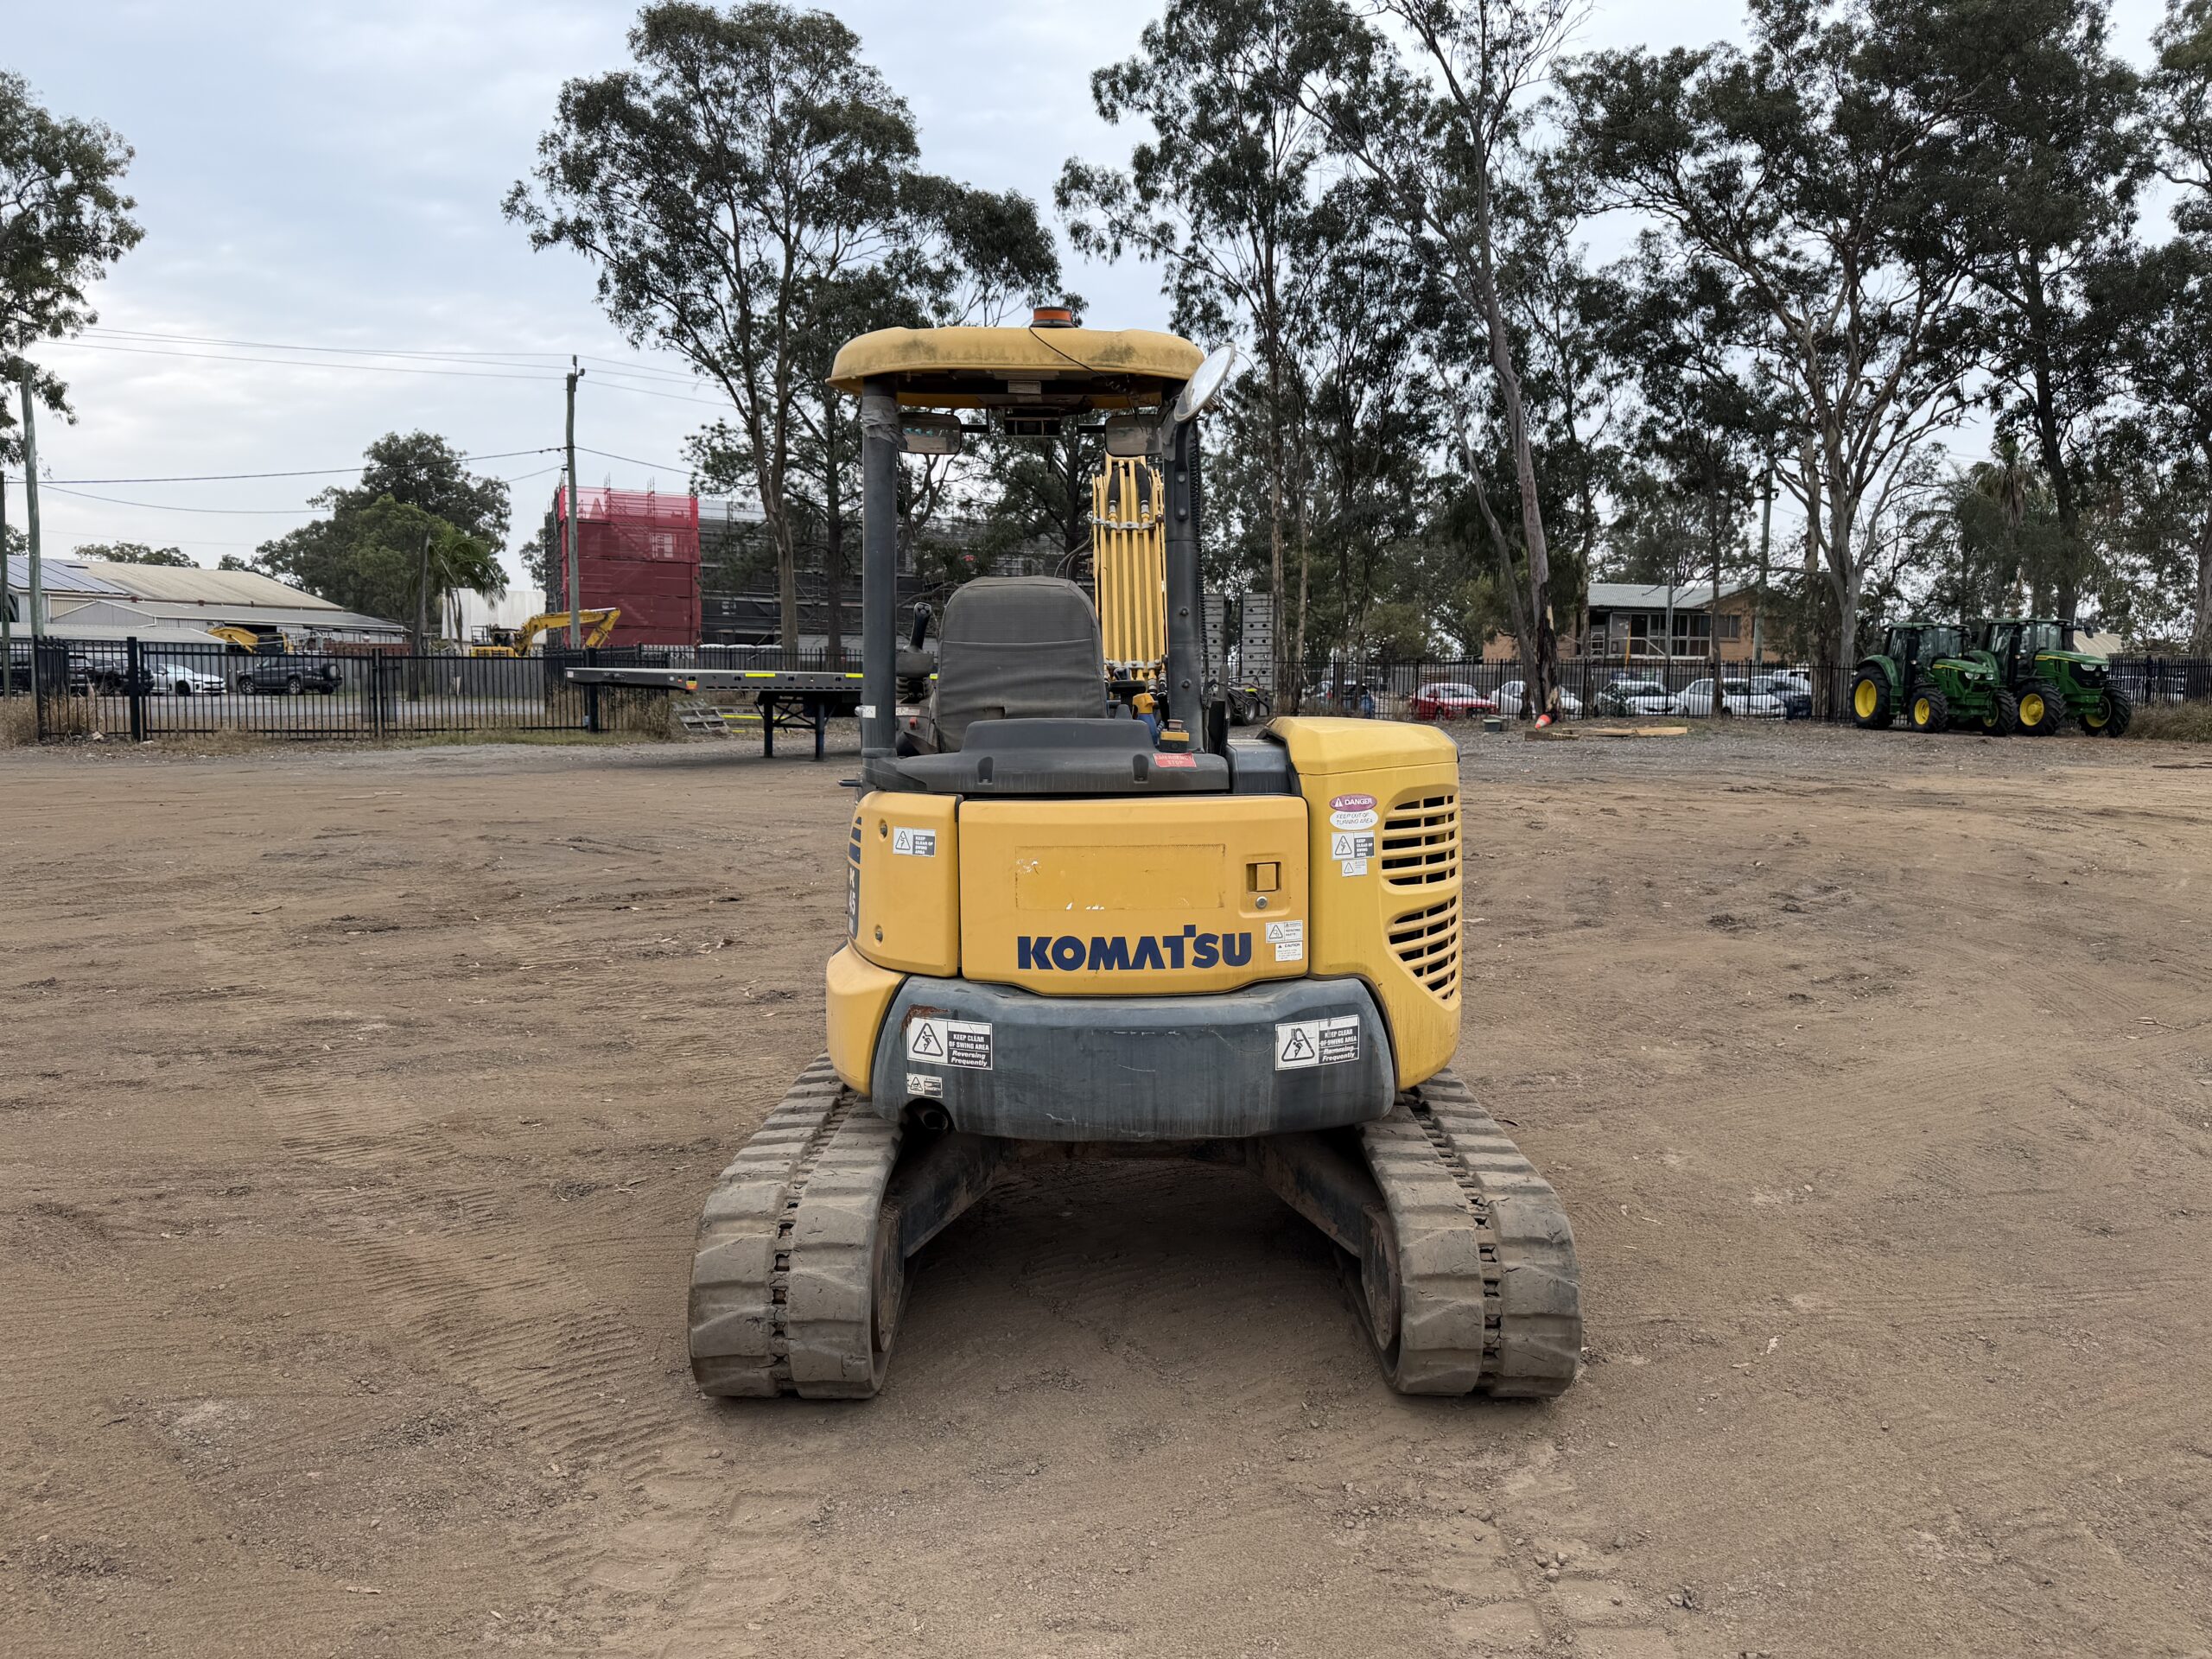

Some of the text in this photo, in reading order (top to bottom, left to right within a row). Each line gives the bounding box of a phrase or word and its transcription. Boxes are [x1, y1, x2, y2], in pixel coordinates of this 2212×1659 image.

[1017, 925, 1252, 971] KOMATSU
[952, 1050, 986, 1059] Reversing
[1322, 1052, 1355, 1062] Frequently
[951, 1057, 987, 1067] Frequently
